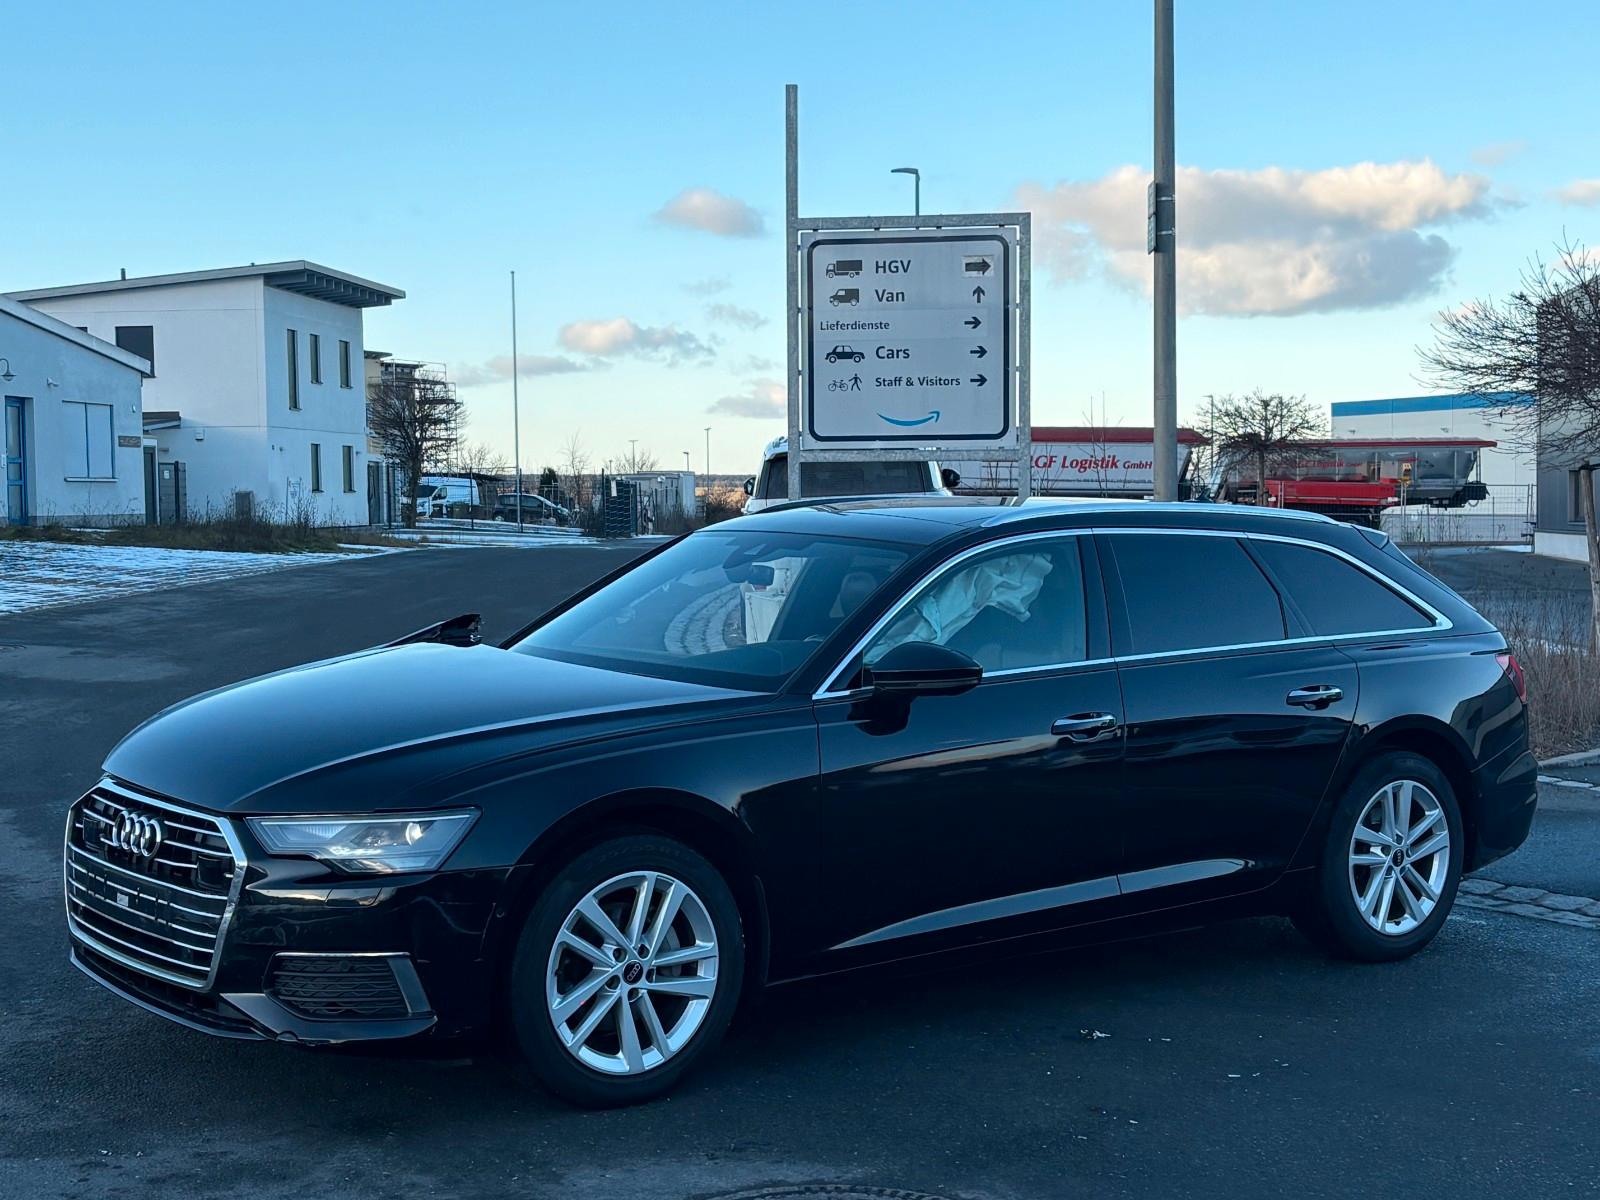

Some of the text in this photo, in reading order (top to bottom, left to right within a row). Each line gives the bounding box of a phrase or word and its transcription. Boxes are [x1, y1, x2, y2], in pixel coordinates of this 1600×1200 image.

[875, 259, 912, 275] HGV
[874, 288, 906, 303] Van
[820, 320, 890, 331] Lieferdienste
[875, 345, 911, 360] Cars
[875, 375, 961, 388] Staff & Visitors
[1061, 454, 1118, 473] Logistik
[1123, 460, 1153, 469] GmbH
